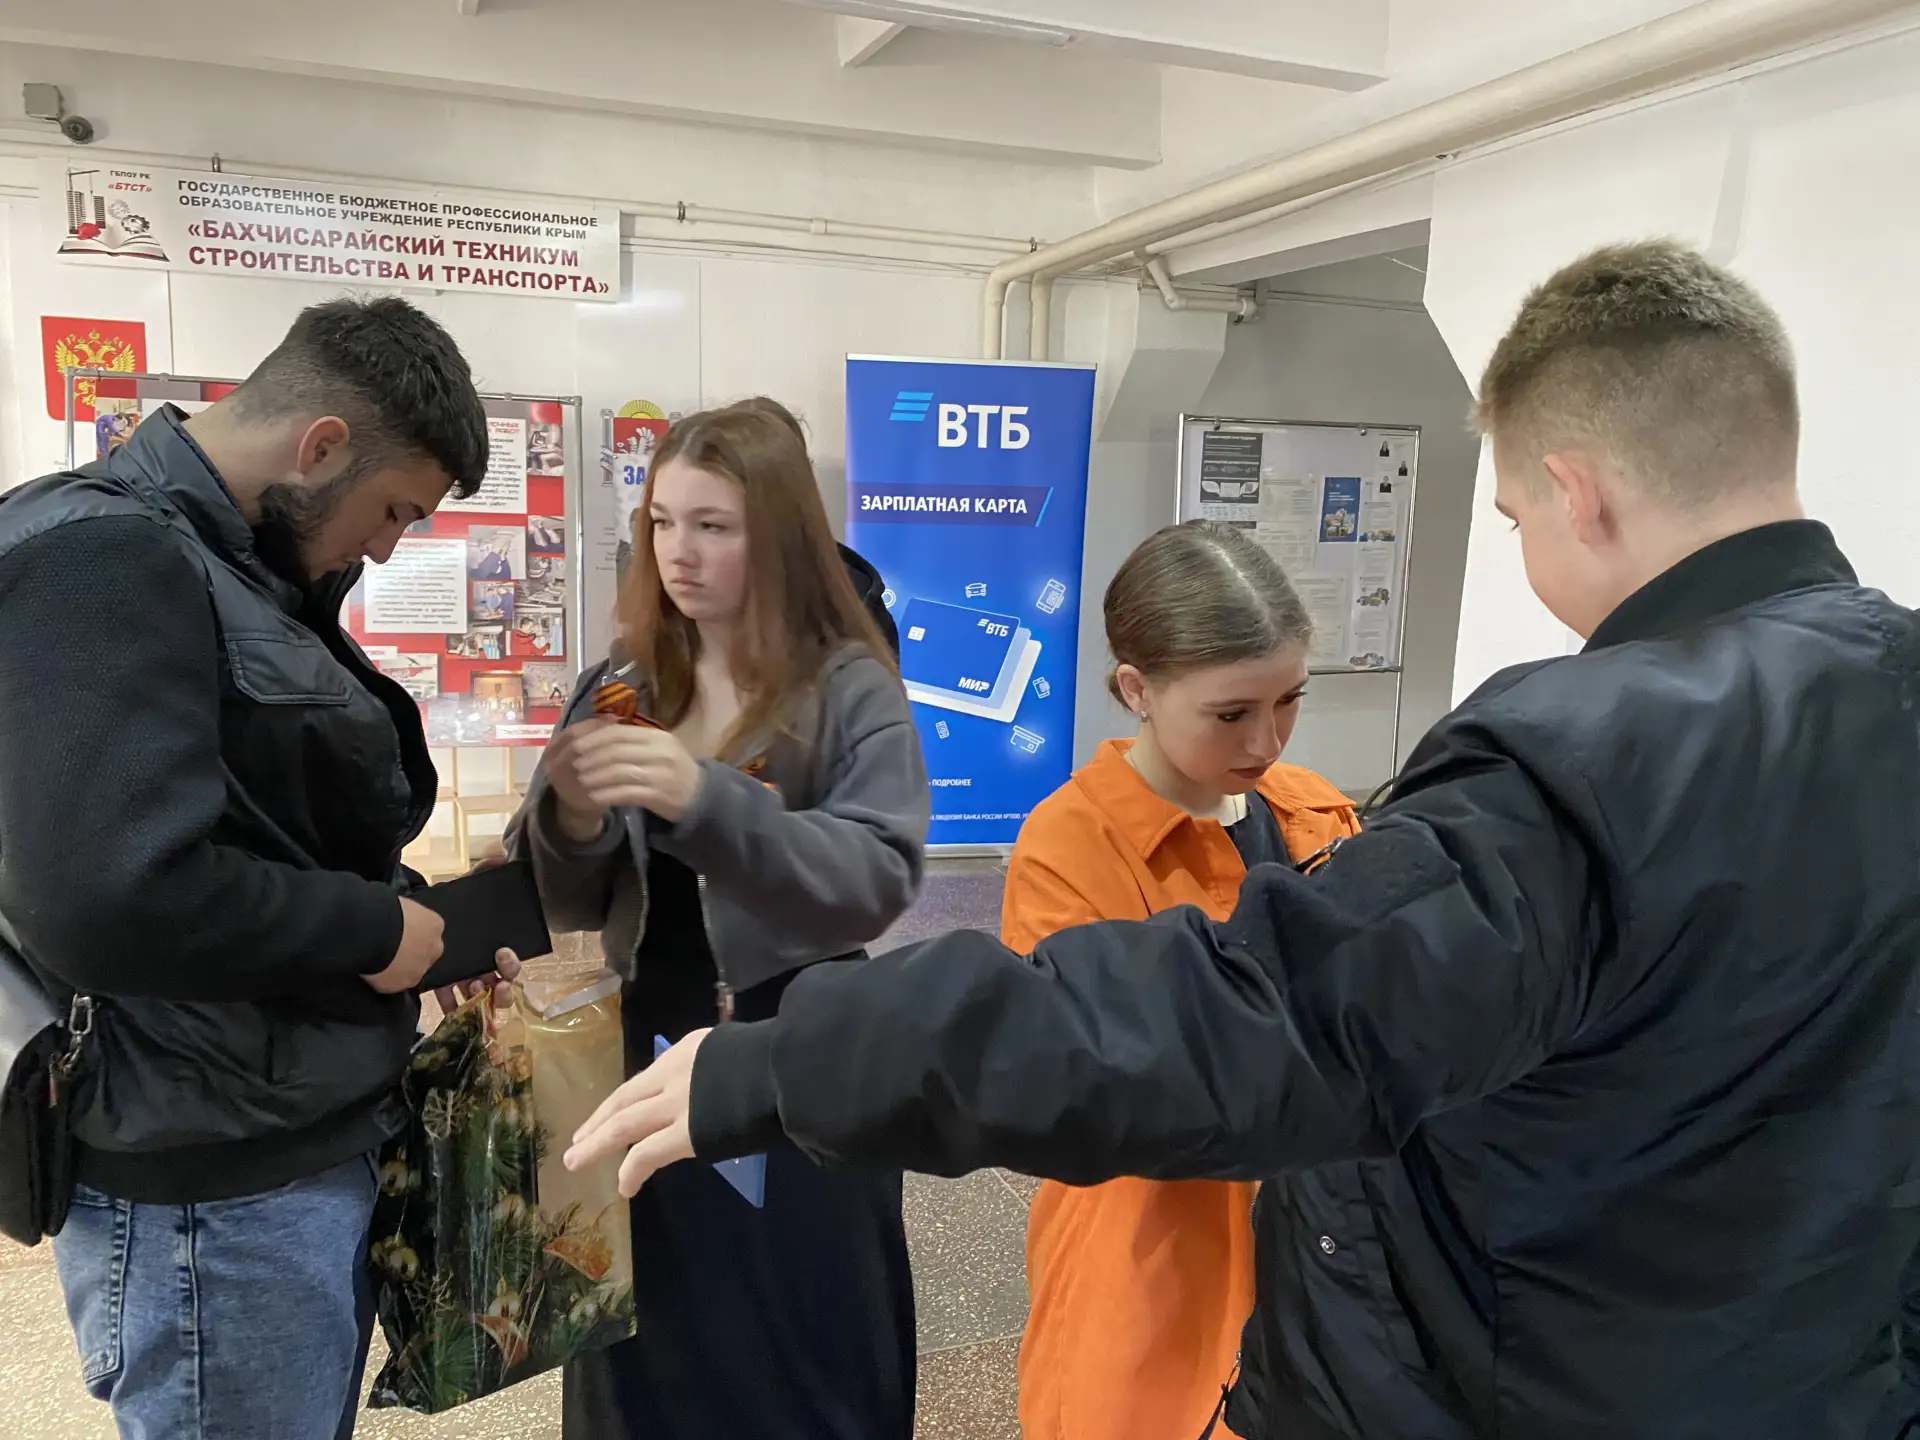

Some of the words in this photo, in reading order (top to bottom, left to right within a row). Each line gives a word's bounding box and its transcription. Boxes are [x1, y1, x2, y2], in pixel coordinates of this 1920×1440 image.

[110, 170, 137, 178] ГБПОУ
[108, 182, 152, 192] «БТСТ»
[178, 180, 334, 204] ГОСУДАРСТВЕННОЕ
[340, 195, 438, 213] БЮДЖЕТНОЕ
[443, 204, 598, 227] ПРОФЕССИОНАЛЬНОЕ
[179, 195, 336, 219] ОБРАЗОВАТЕЛЬНОЕ
[341, 209, 443, 228] УЧРЕЖДЕНИЕ
[447, 218, 541, 236] РЕСПУБЛИКИ
[546, 227, 586, 240] КРЫМ
[188, 219, 445, 256] «БАХЧИСАРАЙСКИЙ
[453, 240, 578, 267] ТЕХНИКУМ
[189, 246, 410, 280] СТРОИТЕЛЬСТВА
[418, 263, 434, 281] И
[442, 265, 609, 294] ТРАНСПОРТА»
[938, 403, 1030, 450] ВТБ
[861, 495, 970, 513] ЗАРПЛАТНАЯ
[974, 498, 1028, 514] КАРТА
[985, 622, 1009, 637] ВТБ
[958, 676, 990, 693] МИР
[932, 779, 971, 787] ПОДРОБНЕЕ
